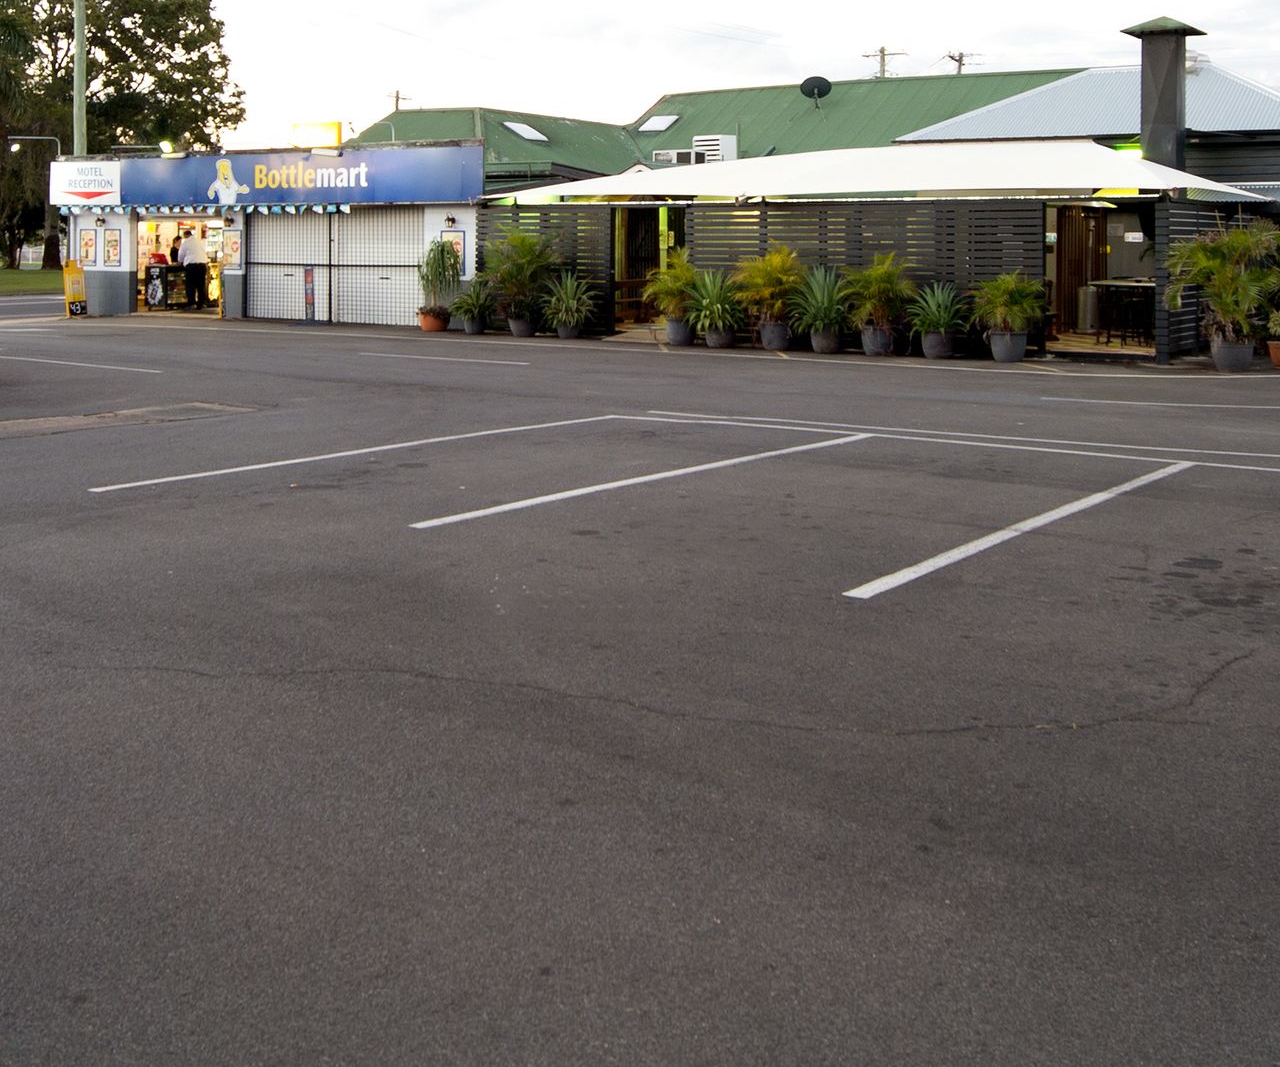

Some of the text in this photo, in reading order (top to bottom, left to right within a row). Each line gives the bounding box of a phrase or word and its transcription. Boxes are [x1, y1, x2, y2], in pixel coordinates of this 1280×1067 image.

[76, 167, 103, 177] MOTEL
[254, 161, 368, 189] Bottlemart
[68, 179, 113, 189] RECEPTION
